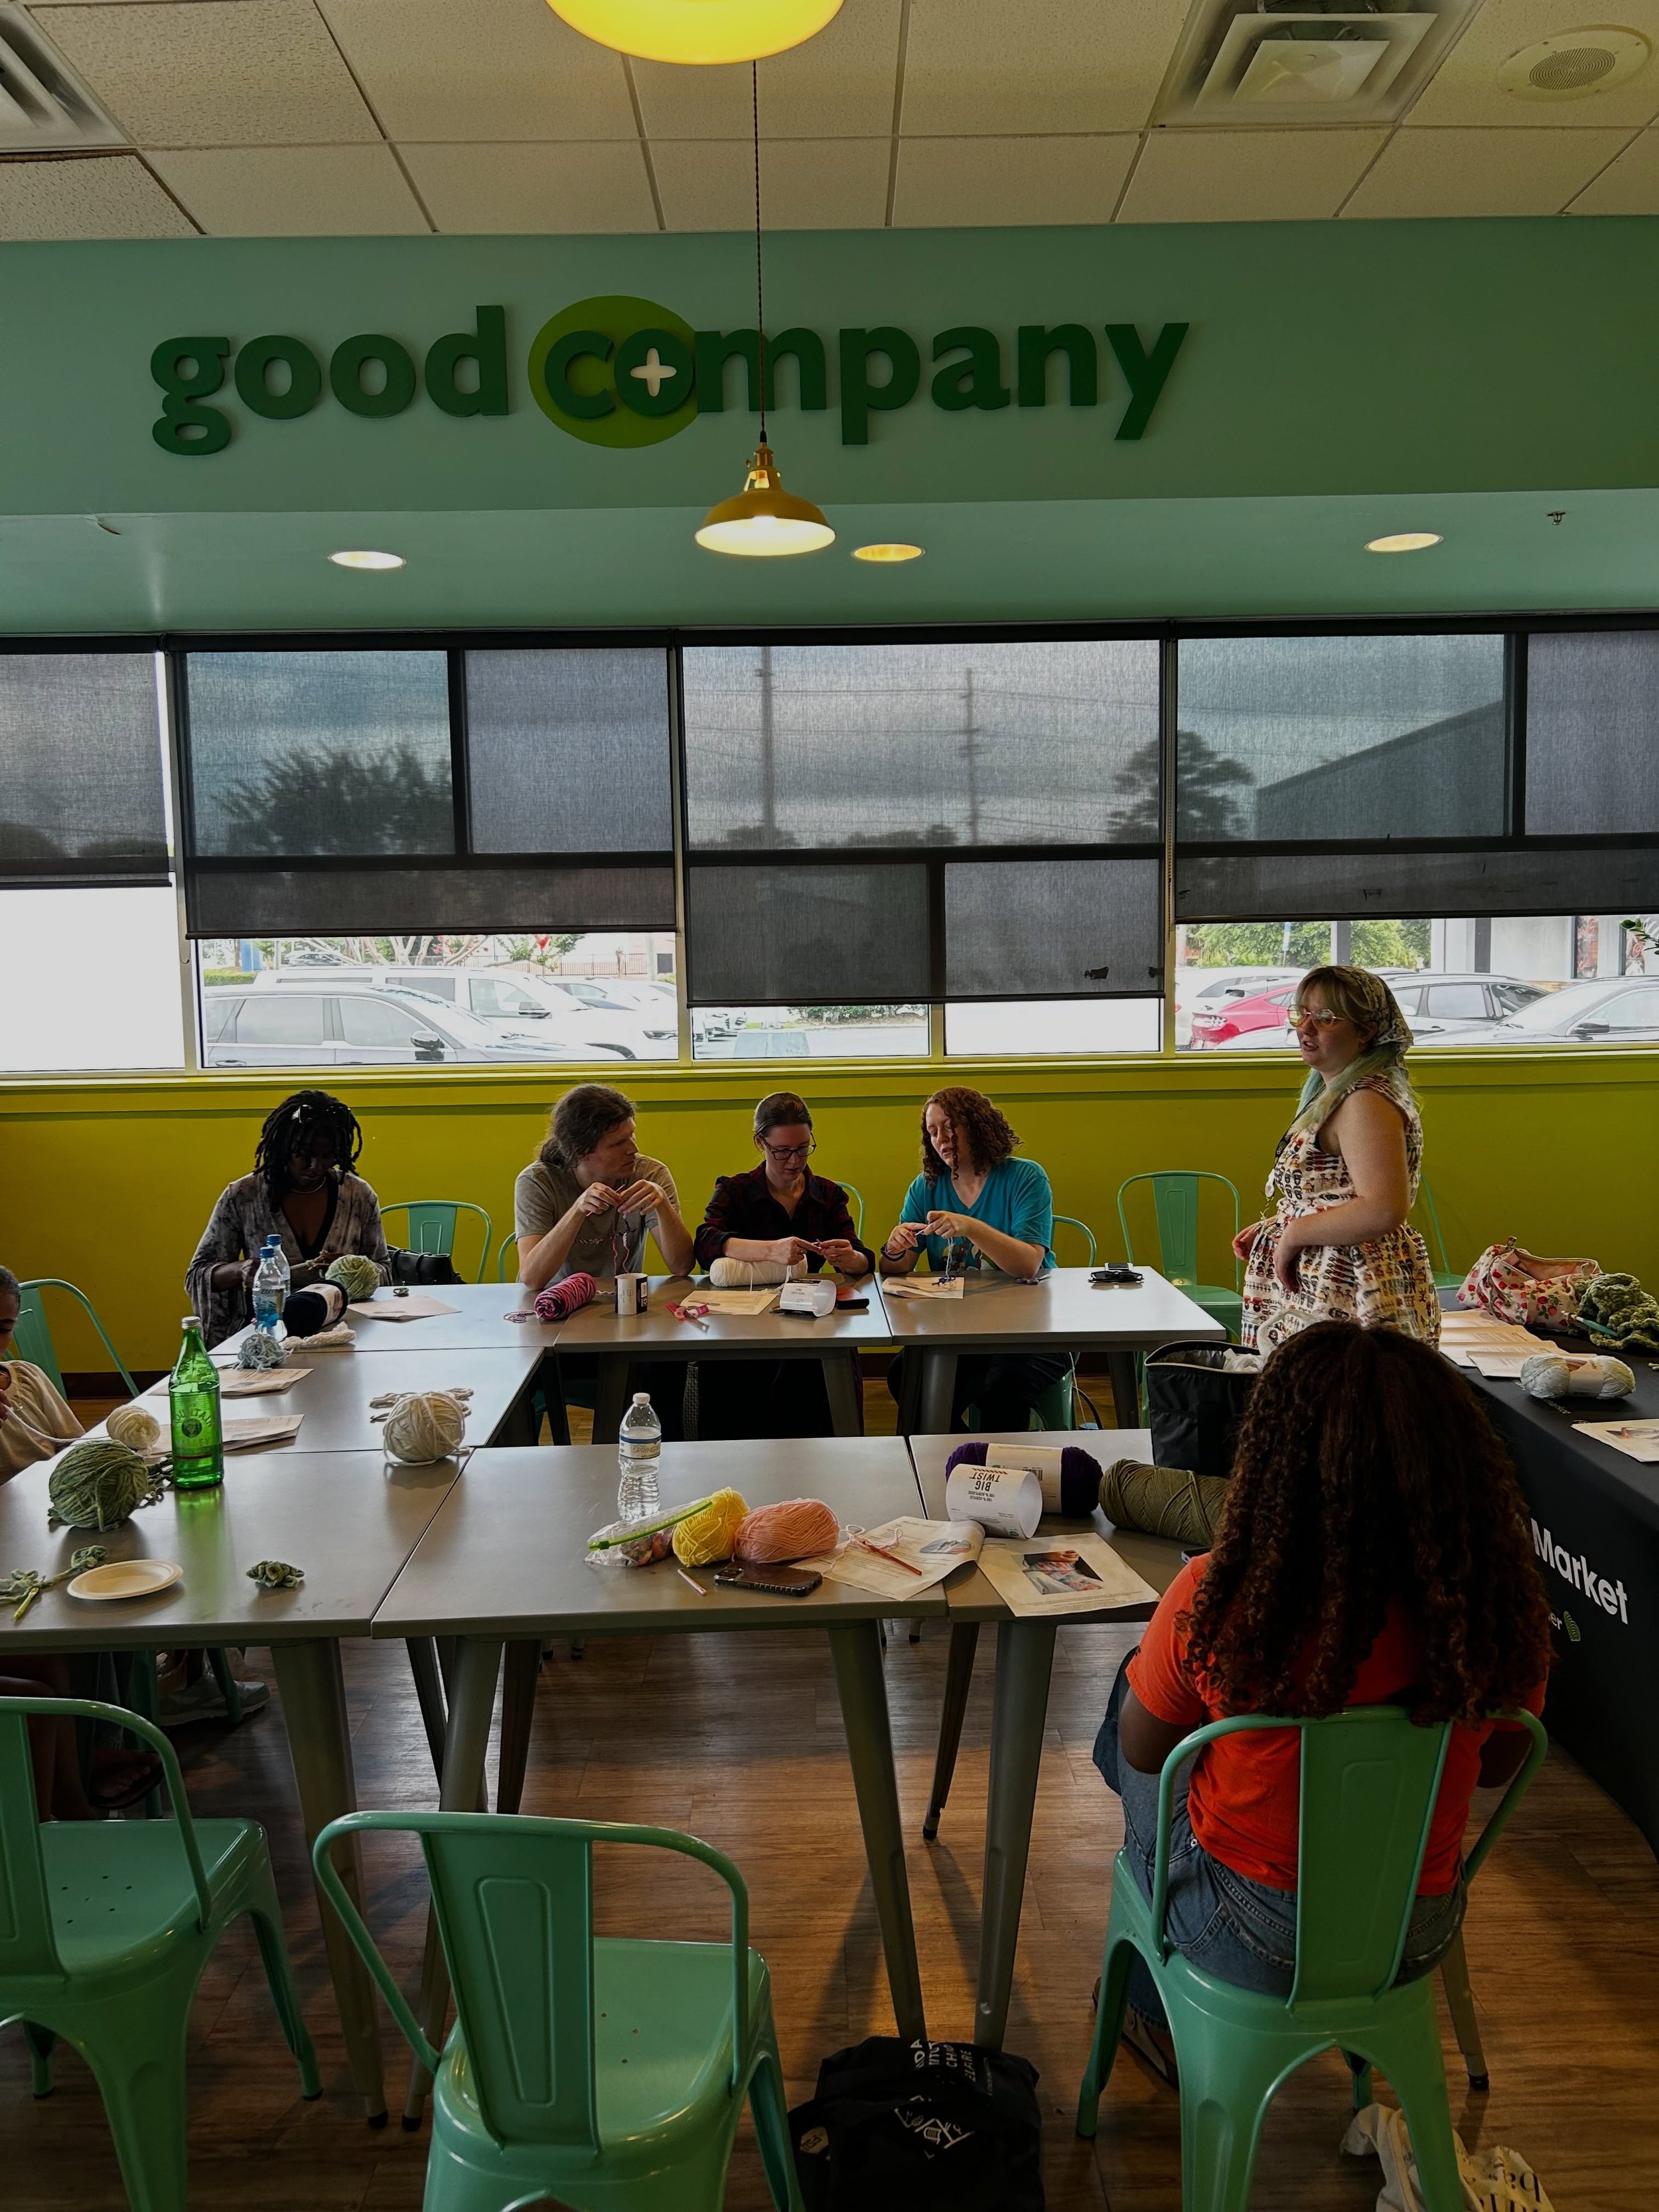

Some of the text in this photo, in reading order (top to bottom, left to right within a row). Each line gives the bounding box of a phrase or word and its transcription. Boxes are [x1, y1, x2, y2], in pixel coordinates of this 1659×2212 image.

[150, 305, 1190, 456] good company
[969, 1472, 1001, 1483] TWIST
[975, 1480, 991, 1491] BIG
[1531, 1518, 1628, 1625] Market
